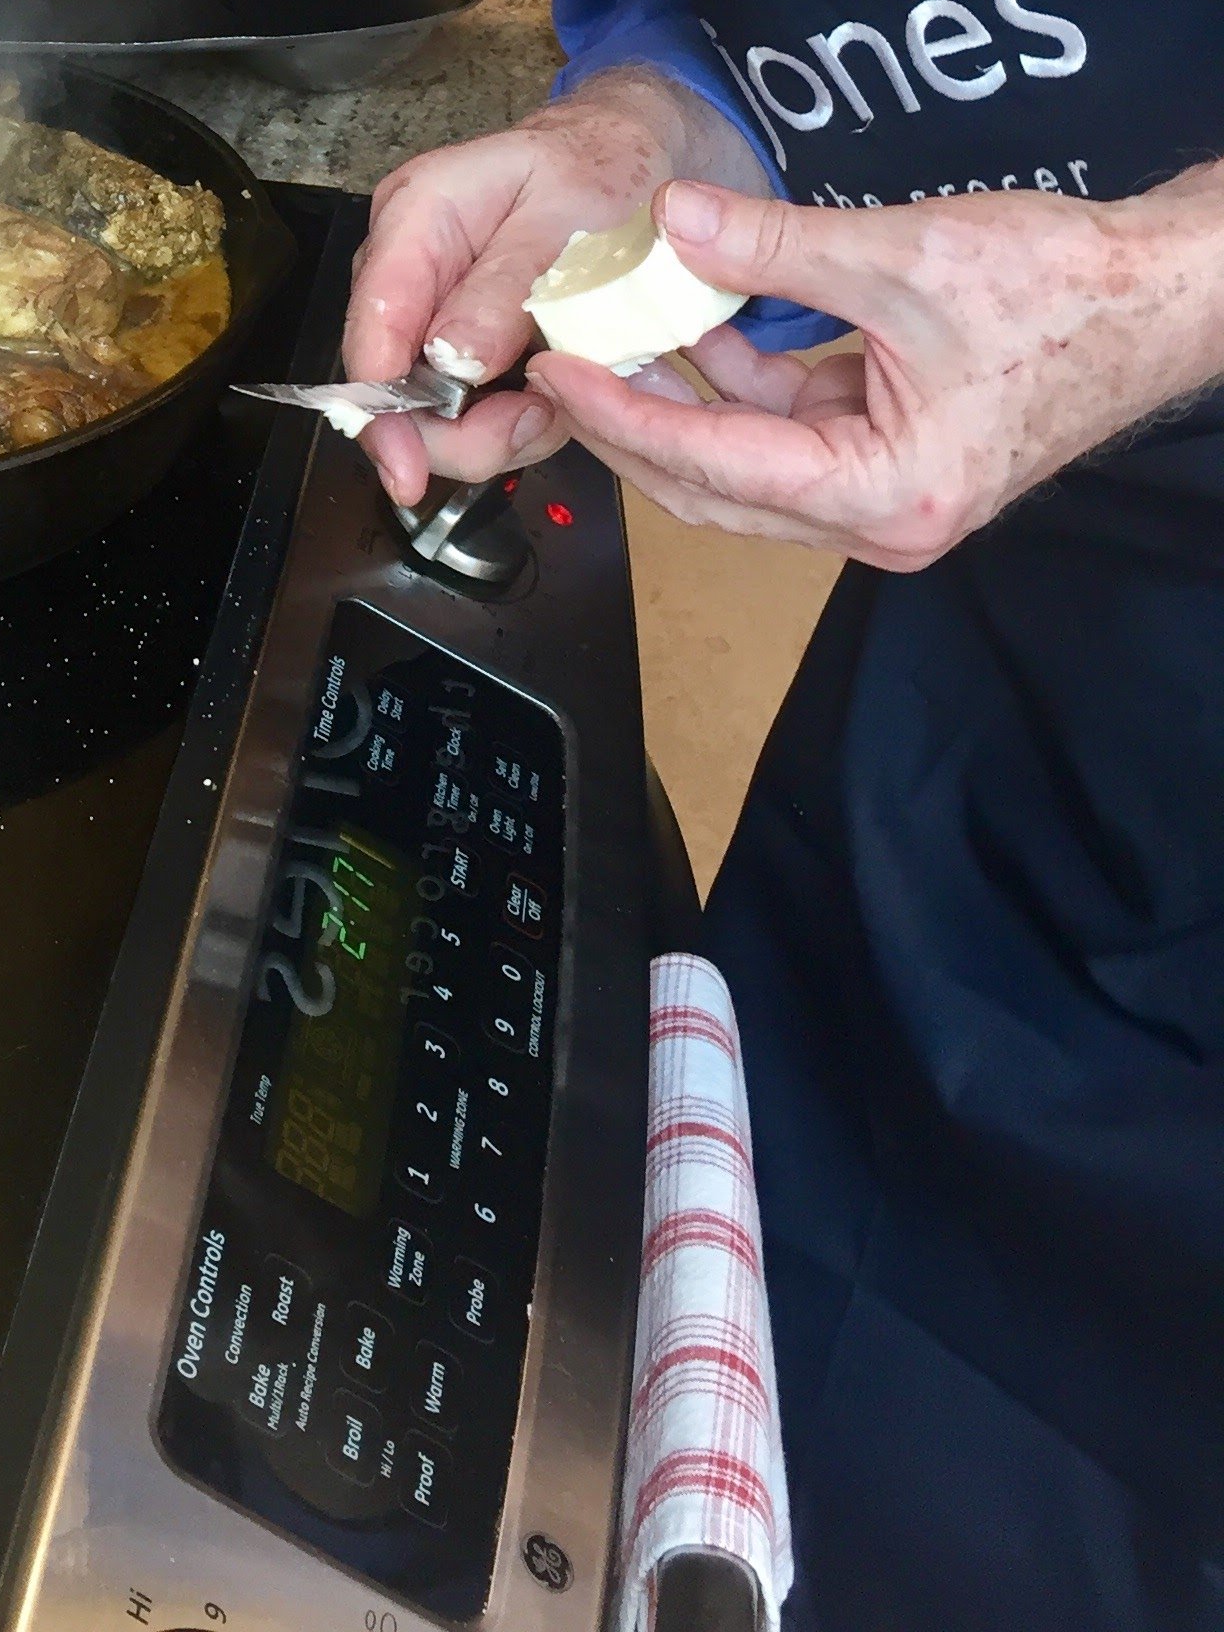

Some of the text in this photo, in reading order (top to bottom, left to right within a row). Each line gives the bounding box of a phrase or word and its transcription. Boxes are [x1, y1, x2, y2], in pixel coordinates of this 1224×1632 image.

[313, 655, 346, 743] Time Controls
[377, 687, 393, 715] Delay
[390, 696, 404, 721] Start
[367, 734, 386, 771] Cooking
[446, 726, 462, 756] Clock
[381, 748, 395, 772] Time
[495, 756, 508, 779] Self
[433, 772, 449, 808] Kitchen
[508, 763, 521, 789] Clean
[447, 783, 461, 811] Timer
[489, 809, 503, 834] Oven
[502, 816, 517, 843] Light
[450, 847, 470, 890] START
[321, 856, 375, 960] 2:17
[506, 883, 523, 916] Clear
[528, 898, 542, 921] Off
[440, 928, 461, 947] 5
[501, 964, 522, 982] 0
[432, 985, 453, 1001] 4
[494, 1018, 515, 1036] 9
[529, 970, 546, 1058] CONTROL LOCKOUT
[425, 1040, 446, 1059] 3
[250, 1074, 272, 1125] True Temp
[488, 1077, 509, 1097] 8
[416, 1102, 438, 1123] 2
[449, 1087, 469, 1170] WARMING ZONE
[481, 1136, 503, 1157] 7
[407, 1166, 430, 1186] 1
[474, 1202, 497, 1224] 6
[387, 1226, 411, 1289] Warming
[408, 1250, 426, 1287] Zone
[176, 1229, 226, 1380] Oven Controls
[271, 1275, 295, 1326] Roast
[465, 1278, 486, 1327] Probe
[224, 1283, 253, 1365] Convection
[355, 1326, 376, 1370] Bake
[295, 1302, 327, 1433] Auto Recipe Conversion
[248, 1363, 271, 1409] Bake
[424, 1361, 446, 1414] Warm
[342, 1415, 363, 1461] Broil
[383, 1440, 396, 1455] Lo
[380, 1461, 392, 1479] Hi
[414, 1451, 436, 1506] Proof
[126, 1587, 153, 1626] Hi
[204, 1601, 227, 1625] 9
